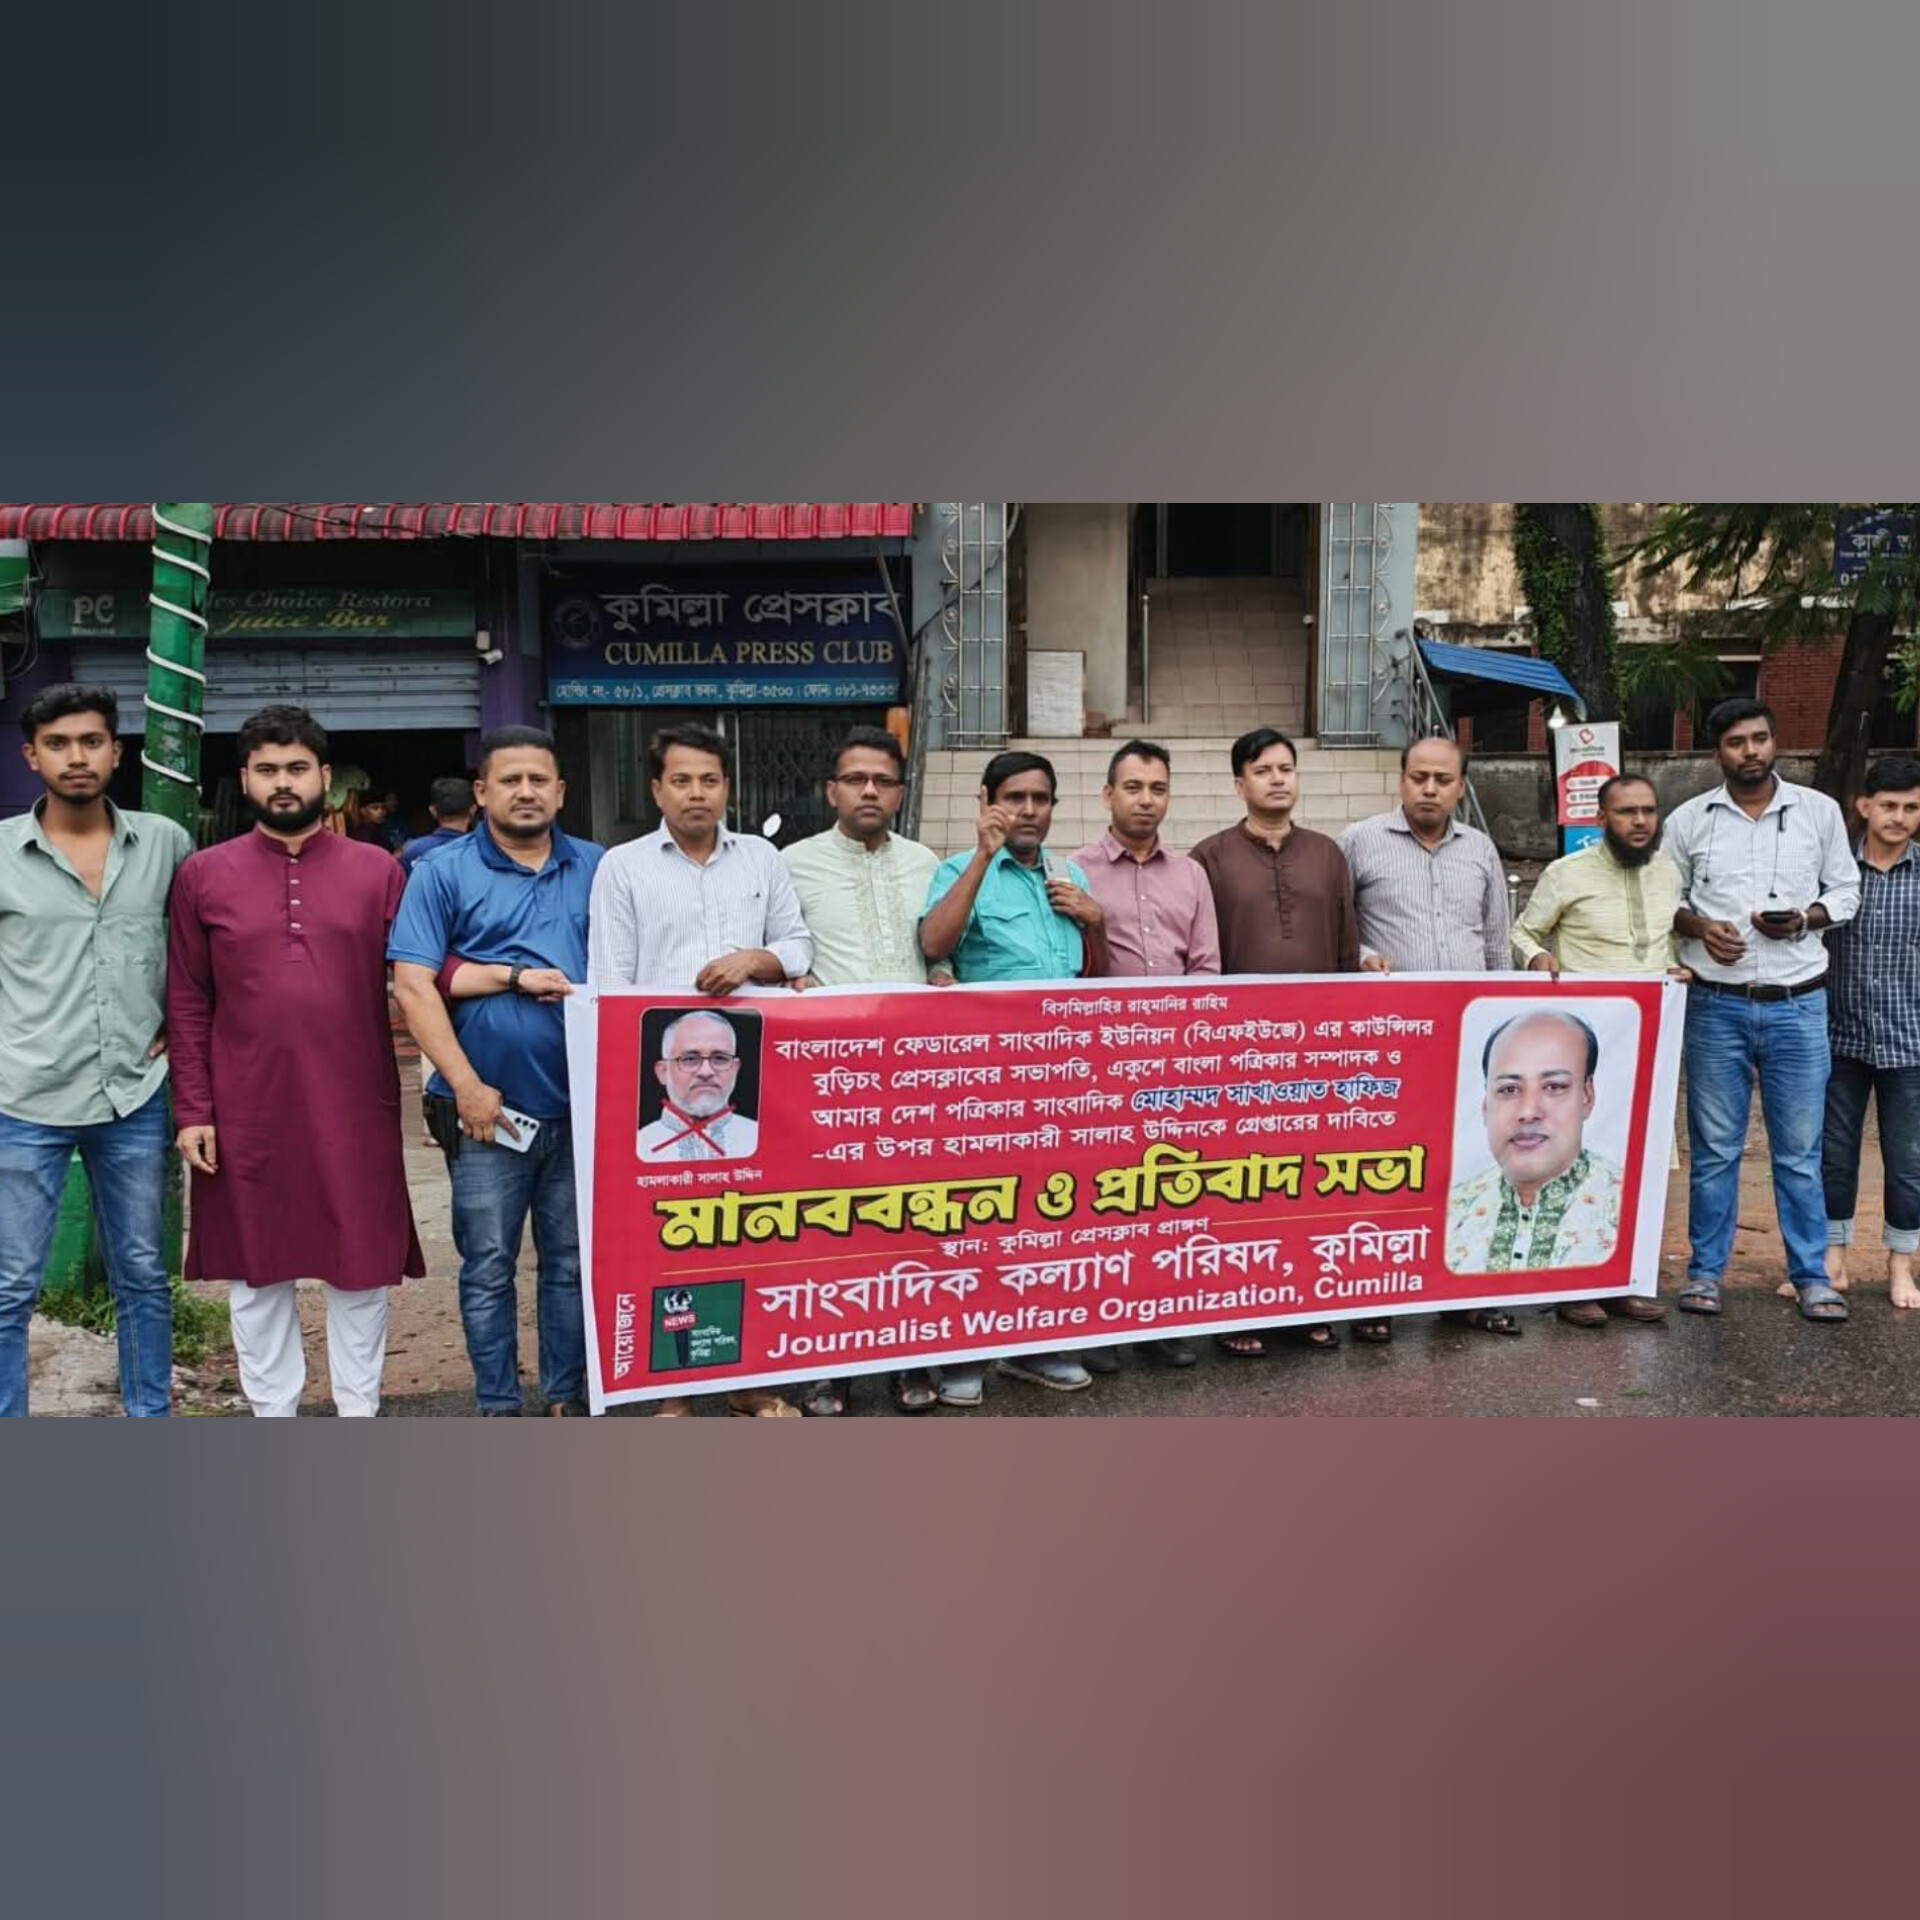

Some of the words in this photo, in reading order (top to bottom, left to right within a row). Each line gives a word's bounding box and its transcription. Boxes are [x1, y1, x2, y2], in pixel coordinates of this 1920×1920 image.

[72, 595, 115, 624] PC
[214, 610, 311, 635] Juice
[318, 608, 391, 628] Bar
[598, 584, 729, 632] কুমিল্লা
[743, 590, 904, 627] প্রেসক্লাব
[604, 641, 728, 666] CUMILLA
[736, 640, 815, 665] PRESS
[822, 640, 895, 664] CLUB
[773, 1036, 885, 1061] বাংলাদেশ
[893, 1032, 991, 1057] ফেডারেল
[998, 1025, 1093, 1053] সাংবাদিক
[1099, 1021, 1177, 1047] ইউনিয়ন
[1183, 1018, 1306, 1048] (বিএফইউজে)
[1314, 1020, 1345, 1039] এর
[811, 1065, 883, 1097] বুড়িচং
[890, 1064, 1002, 1090] প্রেসক্লাবের
[1009, 1056, 1098, 1084] সভাপতি,
[1107, 1056, 1167, 1083] একুশে
[1172, 1053, 1221, 1075] বাংলা
[1228, 1048, 1298, 1073] পত্রিকার
[1303, 1048, 1380, 1070] সম্পাদক
[1387, 1050, 1402, 1065] ও
[811, 1104, 883, 1129] আমার
[891, 1102, 937, 1125] দেশ
[945, 1095, 1027, 1122] পত্রিকার
[1033, 1089, 1125, 1118] সাংবাদিক
[1131, 1083, 1223, 1114] মোহাম্মদ
[1226, 1078, 1330, 1108] সাখাওয়াত
[1332, 1071, 1402, 1104] হাফিজ
[874, 1134, 935, 1159] উপর
[942, 1123, 1061, 1158] হামলাকারী
[1070, 1122, 1136, 1147] সালাহ
[1141, 1115, 1228, 1140] উদ্দিনকে
[1236, 1112, 1320, 1136] গ্রেপ্তারের
[1326, 1106, 1398, 1131] দাবিতে
[655, 1174, 1021, 1250] মানববন্ধন
[1035, 1171, 1077, 1220] ও
[1091, 1142, 1303, 1215] প্রতিবাদ
[1313, 1143, 1426, 1196] সভা
[939, 1238, 989, 1259] স্থান:
[997, 1228, 1064, 1255] কুমিল্লা
[1071, 1221, 1152, 1246] প্রেসক্লাব
[1157, 1216, 1211, 1237] প্রাঙ্গণ
[755, 1260, 983, 1322] সাংবাদিক
[996, 1249, 1136, 1296] কল্যাণ
[1151, 1233, 1295, 1281] পরিষদ,
[1308, 1221, 1433, 1275] কুমিল্লা
[614, 1293, 637, 1381] আয়োজনে
[664, 1313, 697, 1327] NEWS
[766, 1315, 952, 1360] Journalist
[961, 1303, 1088, 1337] Welfare
[1098, 1281, 1305, 1323] Organization,
[1313, 1270, 1424, 1300] Cumilla
